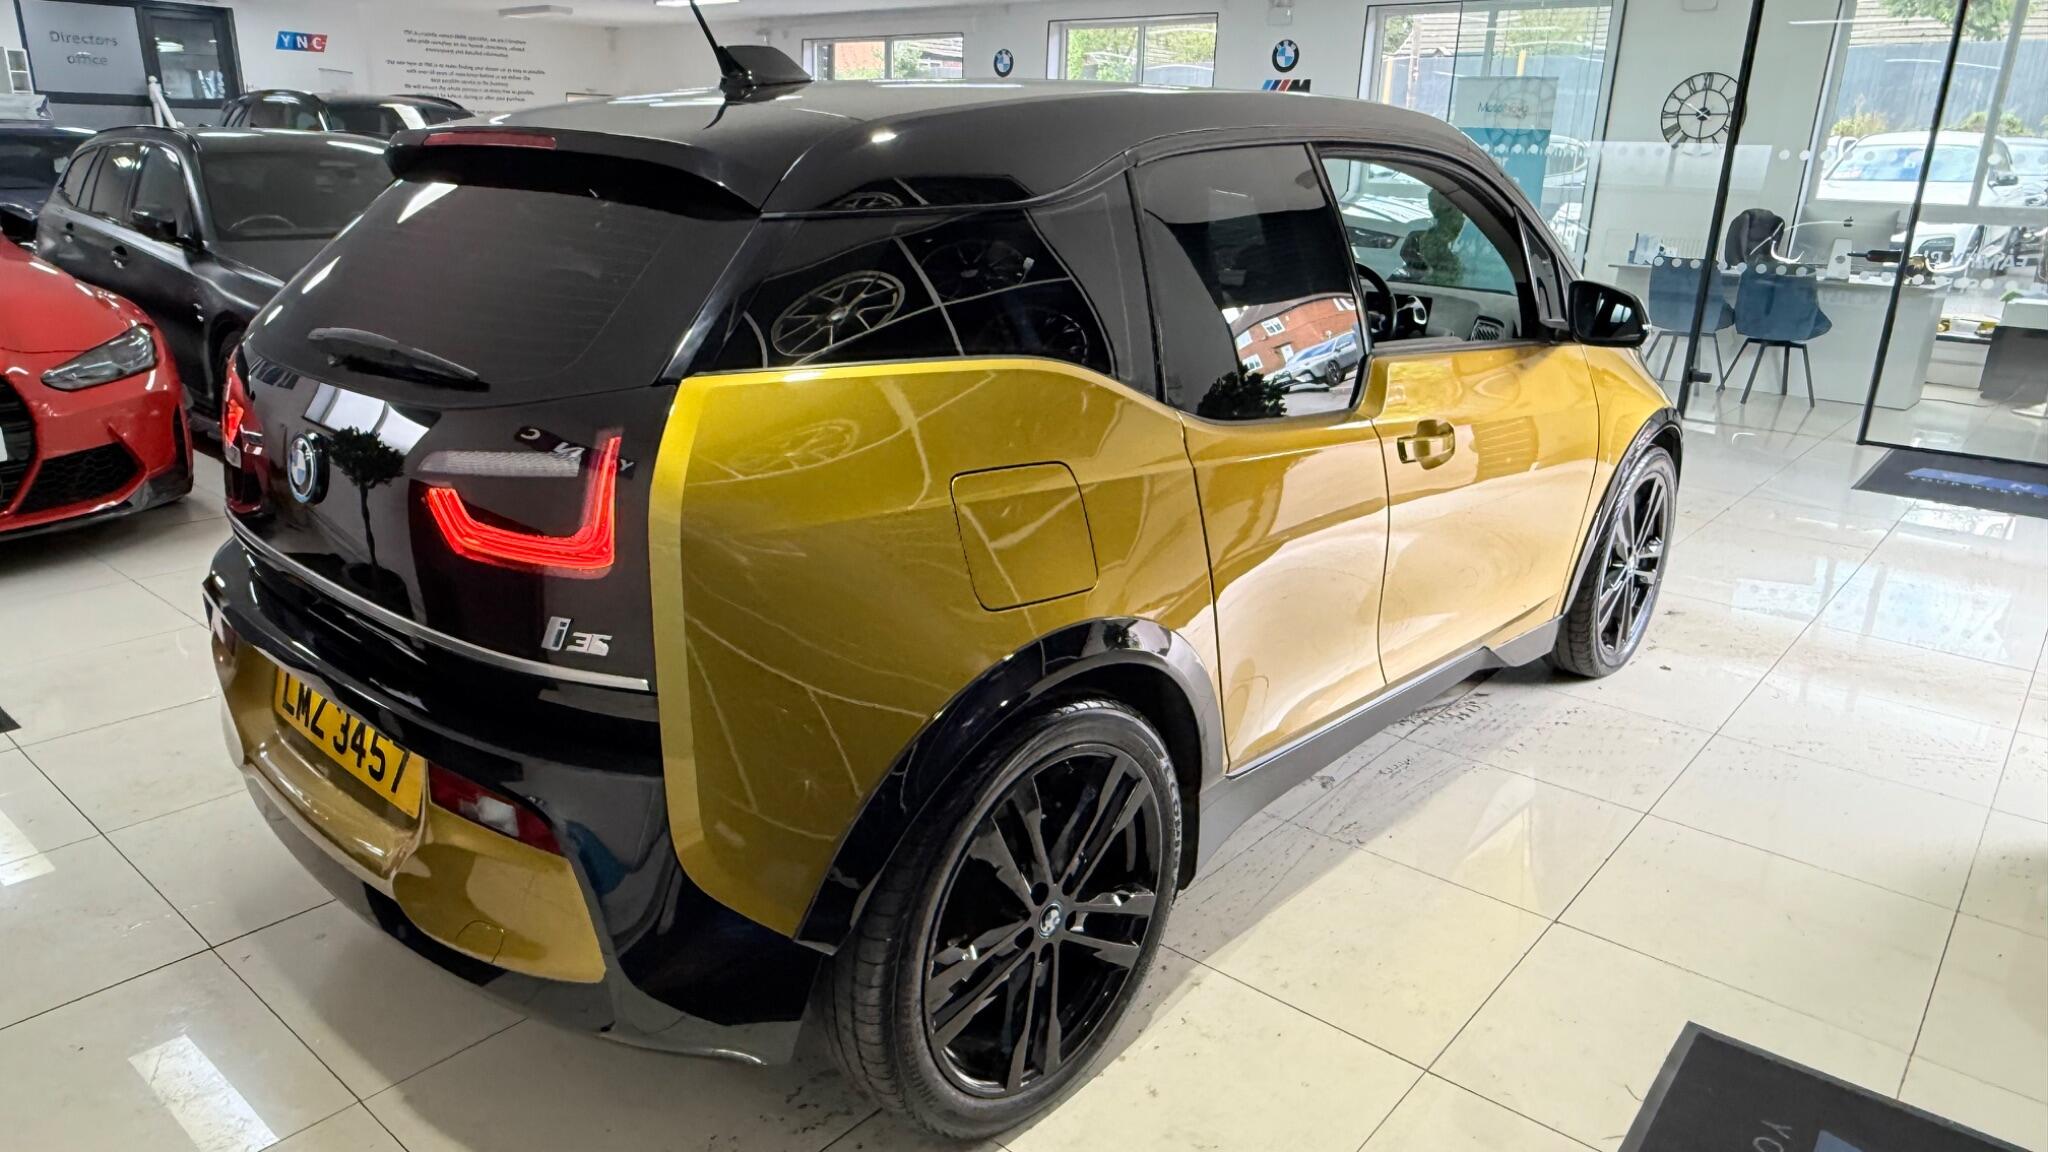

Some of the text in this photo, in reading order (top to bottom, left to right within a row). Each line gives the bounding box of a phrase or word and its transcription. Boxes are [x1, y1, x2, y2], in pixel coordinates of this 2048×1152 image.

[49, 30, 119, 47] Directors
[280, 34, 323, 50] YNC
[66, 53, 109, 66] office
[282, 672, 411, 794] LMZ 3457
